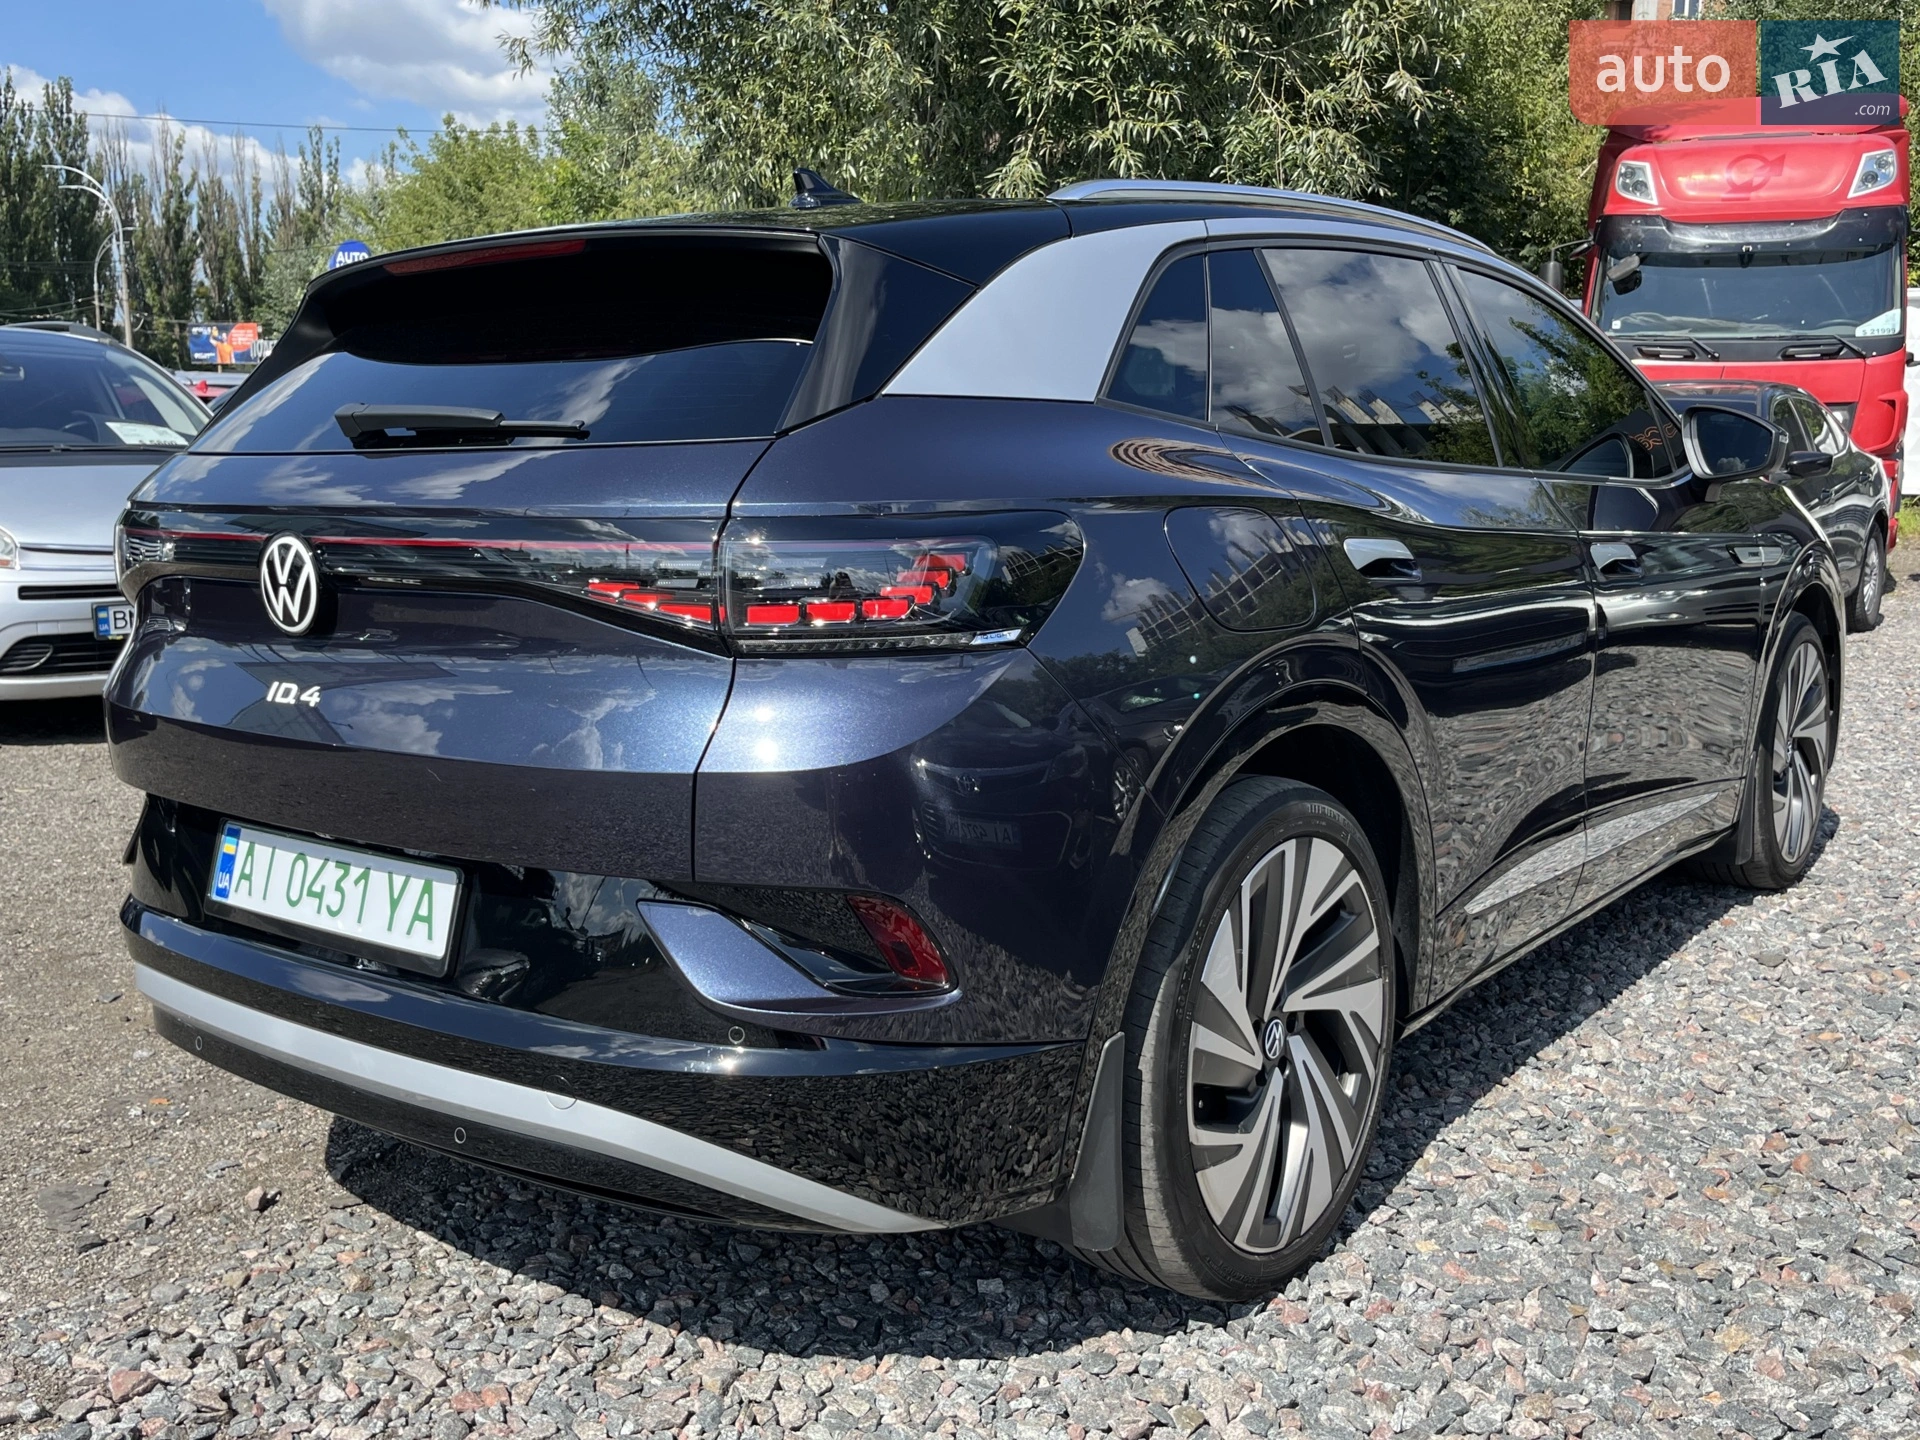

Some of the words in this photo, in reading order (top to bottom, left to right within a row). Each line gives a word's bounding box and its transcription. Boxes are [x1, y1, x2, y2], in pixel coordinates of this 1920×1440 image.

[335, 251, 369, 268] AUTO
[217, 871, 230, 888] UA
[286, 852, 371, 924] 0431
[387, 871, 434, 940] YA
